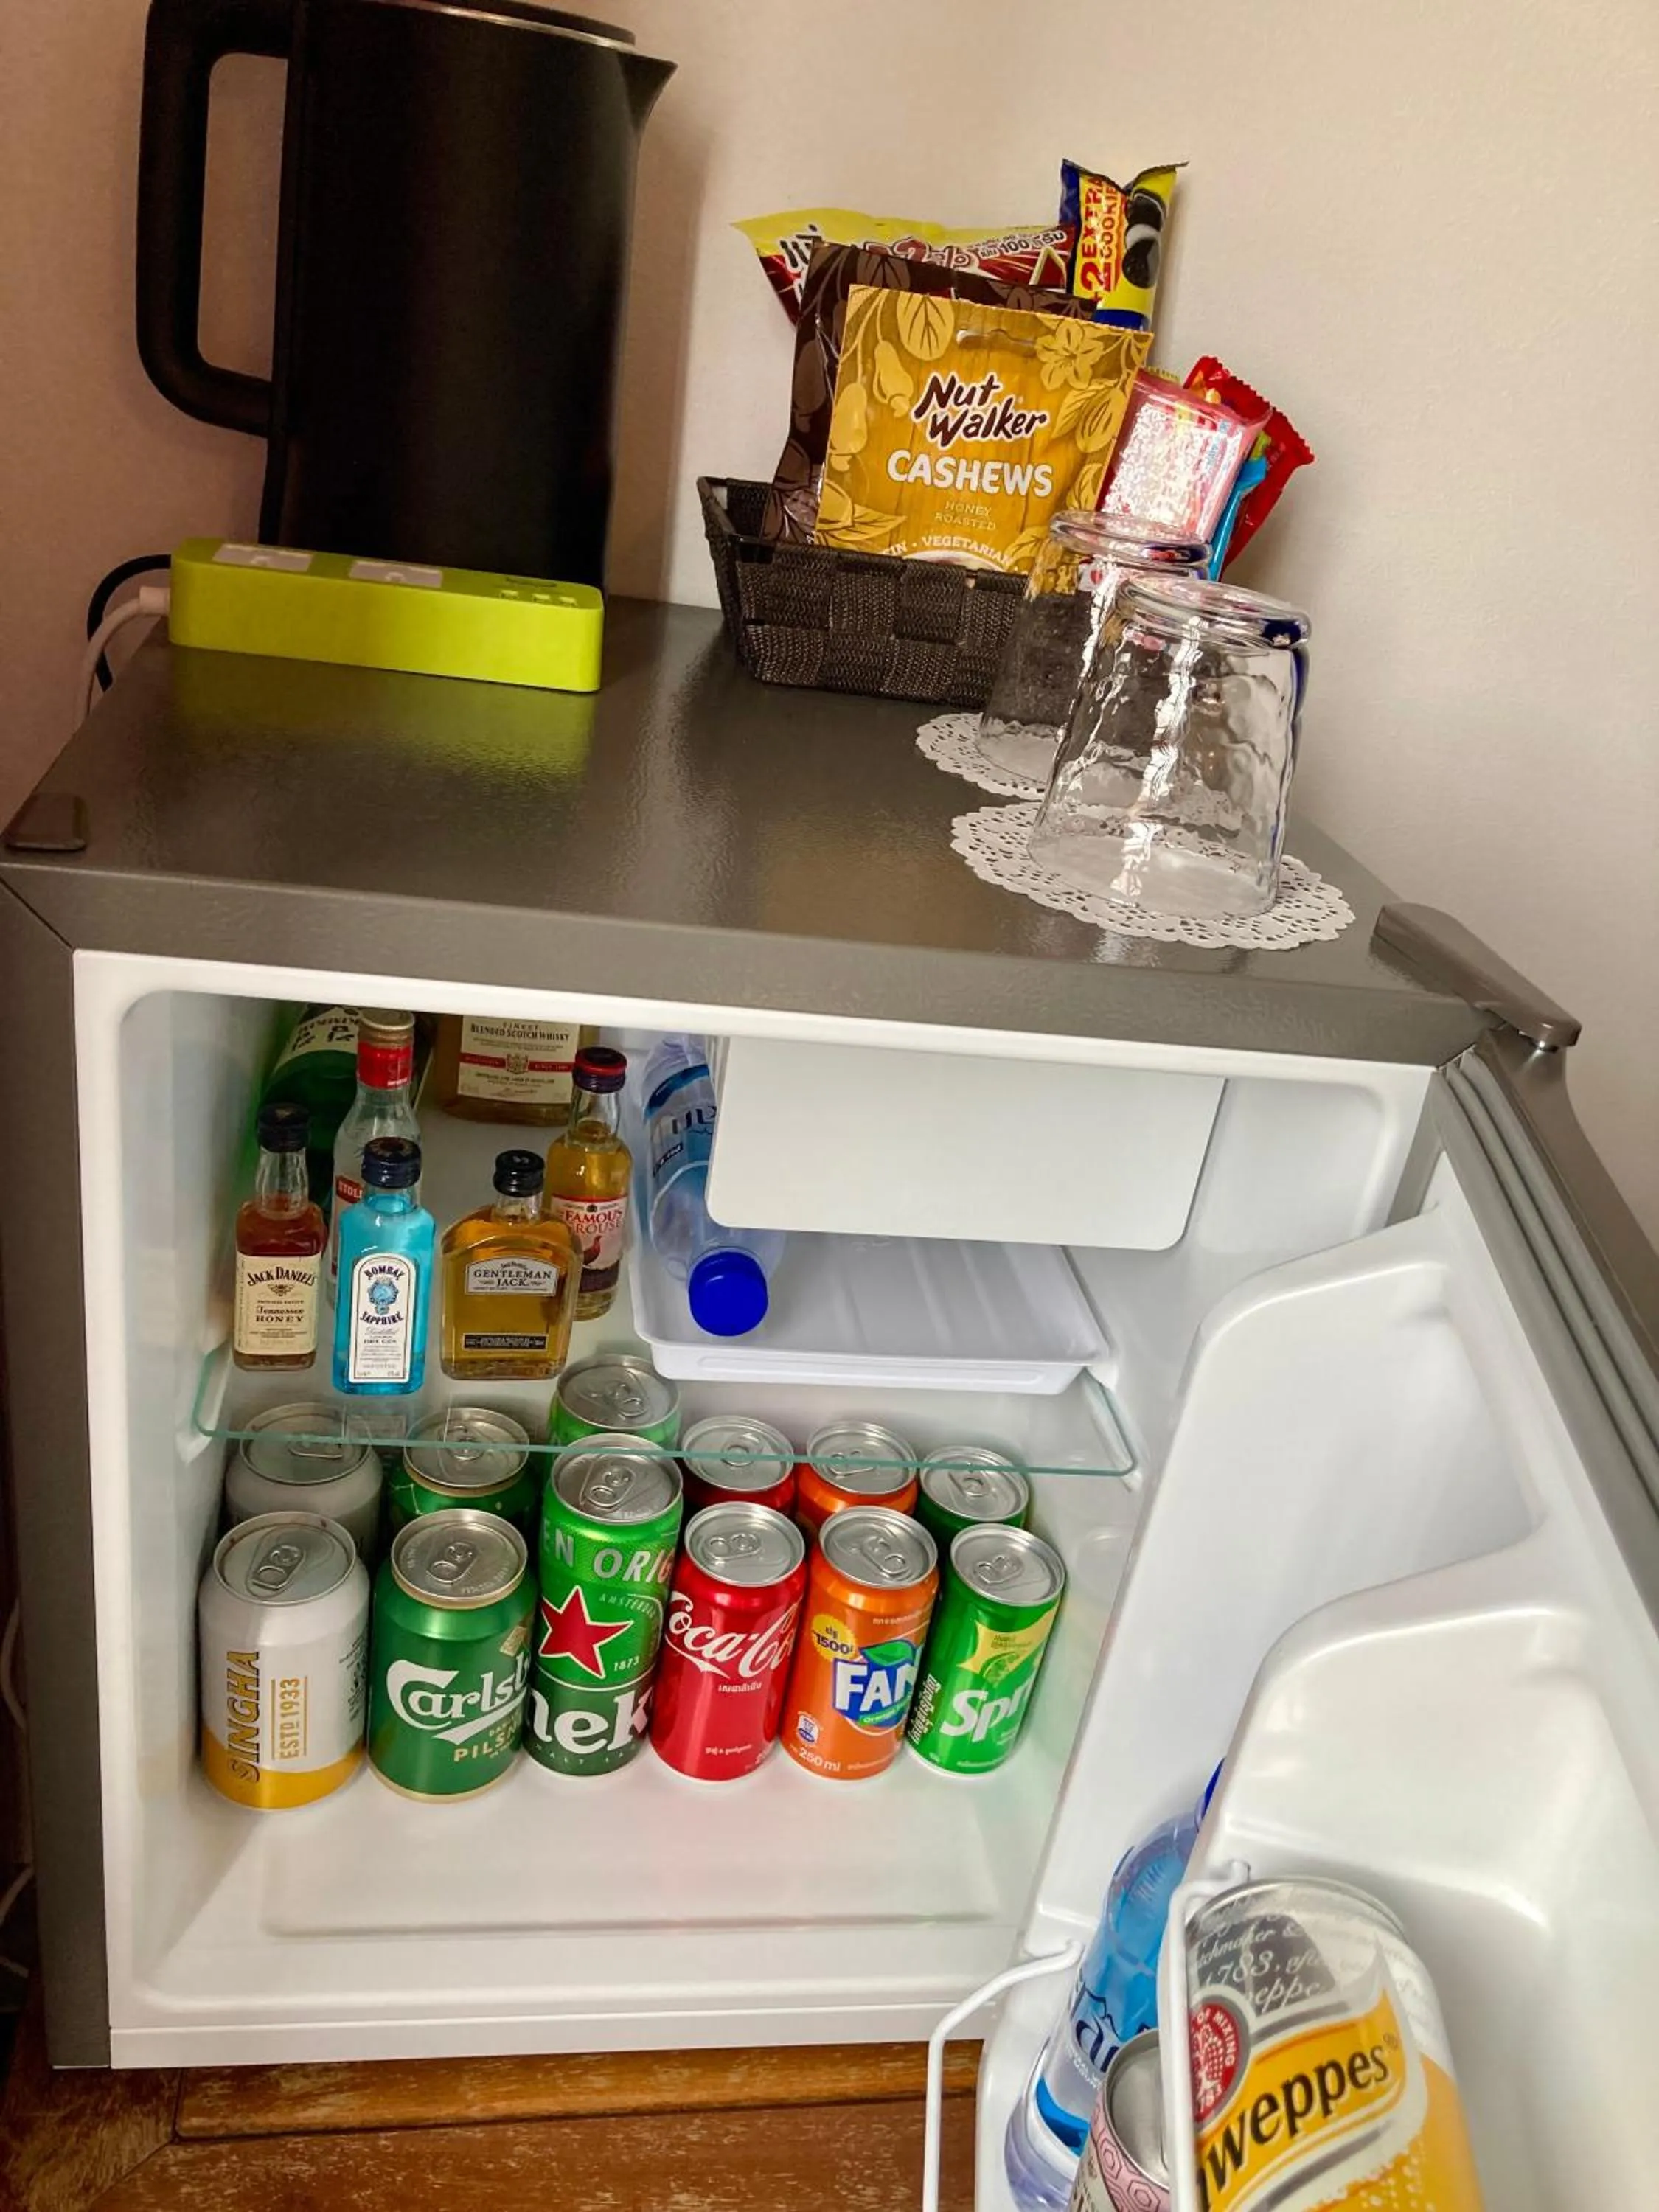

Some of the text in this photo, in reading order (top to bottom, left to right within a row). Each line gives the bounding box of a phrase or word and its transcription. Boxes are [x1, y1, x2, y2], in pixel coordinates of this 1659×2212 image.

[999, 238, 1030, 253] 100
[914, 373, 1001, 419] Nut
[929, 397, 1047, 448] Walker
[887, 450, 1053, 498] CASHEWS
[945, 501, 992, 517] HONEY
[934, 512, 996, 531] ROASTED
[922, 535, 1014, 567] VEGETARIAN
[470, 1023, 569, 1041] BLENDED SCOTCH WHISKY
[576, 1219, 621, 1234] ROUSE
[247, 1270, 274, 1287] JACK
[364, 1265, 406, 1281] BOMBAY
[473, 1268, 552, 1279] GENTLEMAN
[496, 1278, 529, 1287] JACK
[255, 1315, 304, 1323] HONEY
[359, 1310, 405, 1326] SAPPHIRE
[613, 1655, 640, 1672] 1873
[279, 1677, 301, 1719] 1933
[226, 1651, 260, 1782] SINGHA
[799, 1747, 823, 1767] 250
[824, 1760, 841, 1773] ml
[1197, 2007, 1236, 2067] OF MIXING
